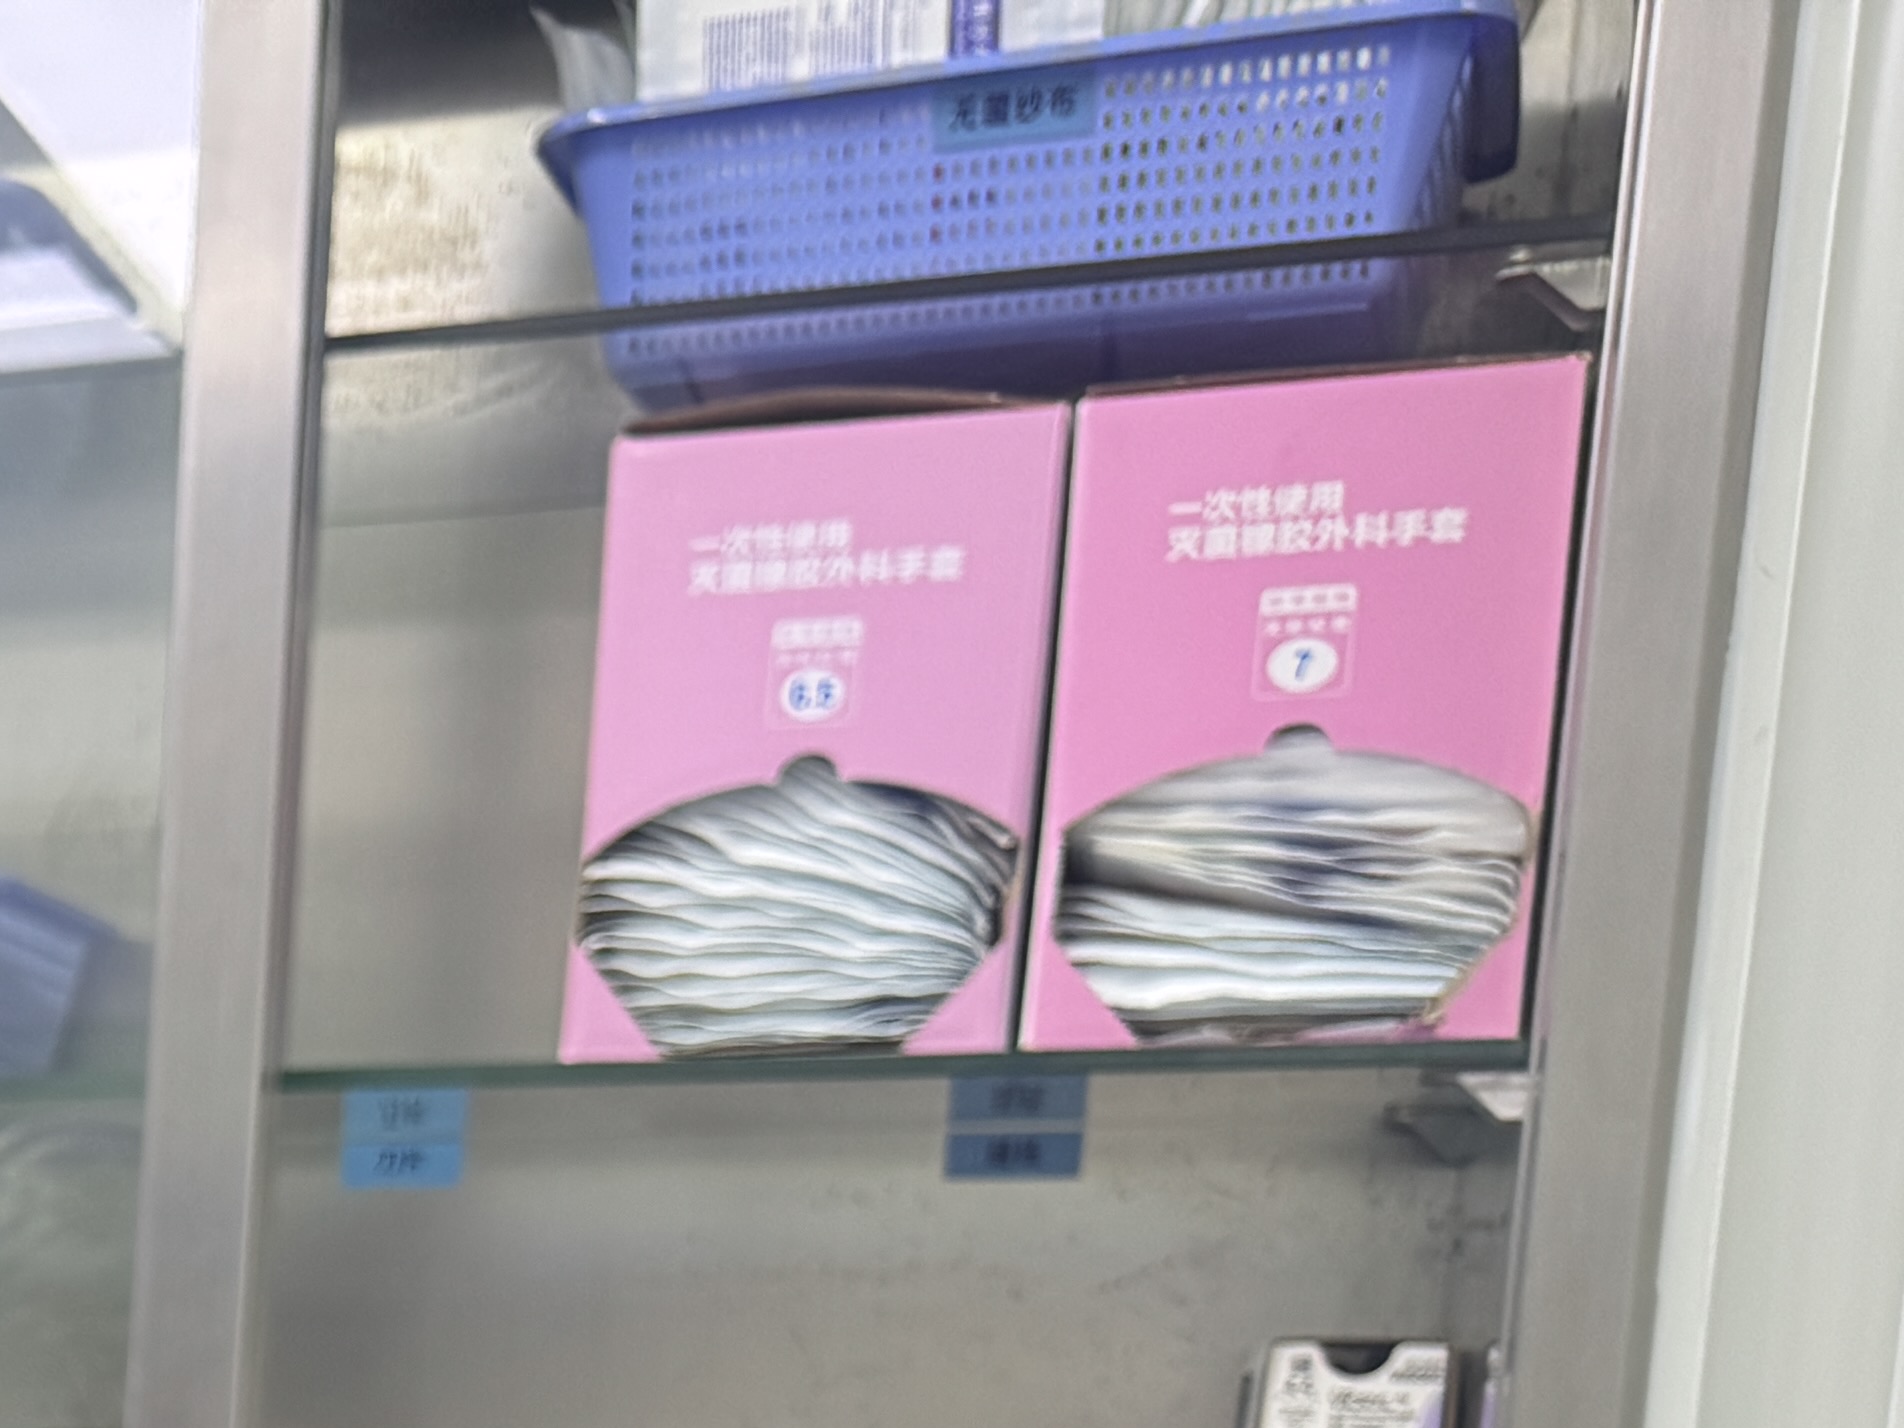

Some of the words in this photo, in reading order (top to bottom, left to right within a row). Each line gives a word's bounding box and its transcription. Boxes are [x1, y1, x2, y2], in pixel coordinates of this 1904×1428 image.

[1167, 480, 1345, 523] 一次性使用
[1165, 506, 1469, 563] 灭菌橡胶外科手套
[1294, 649, 1314, 681] 7
